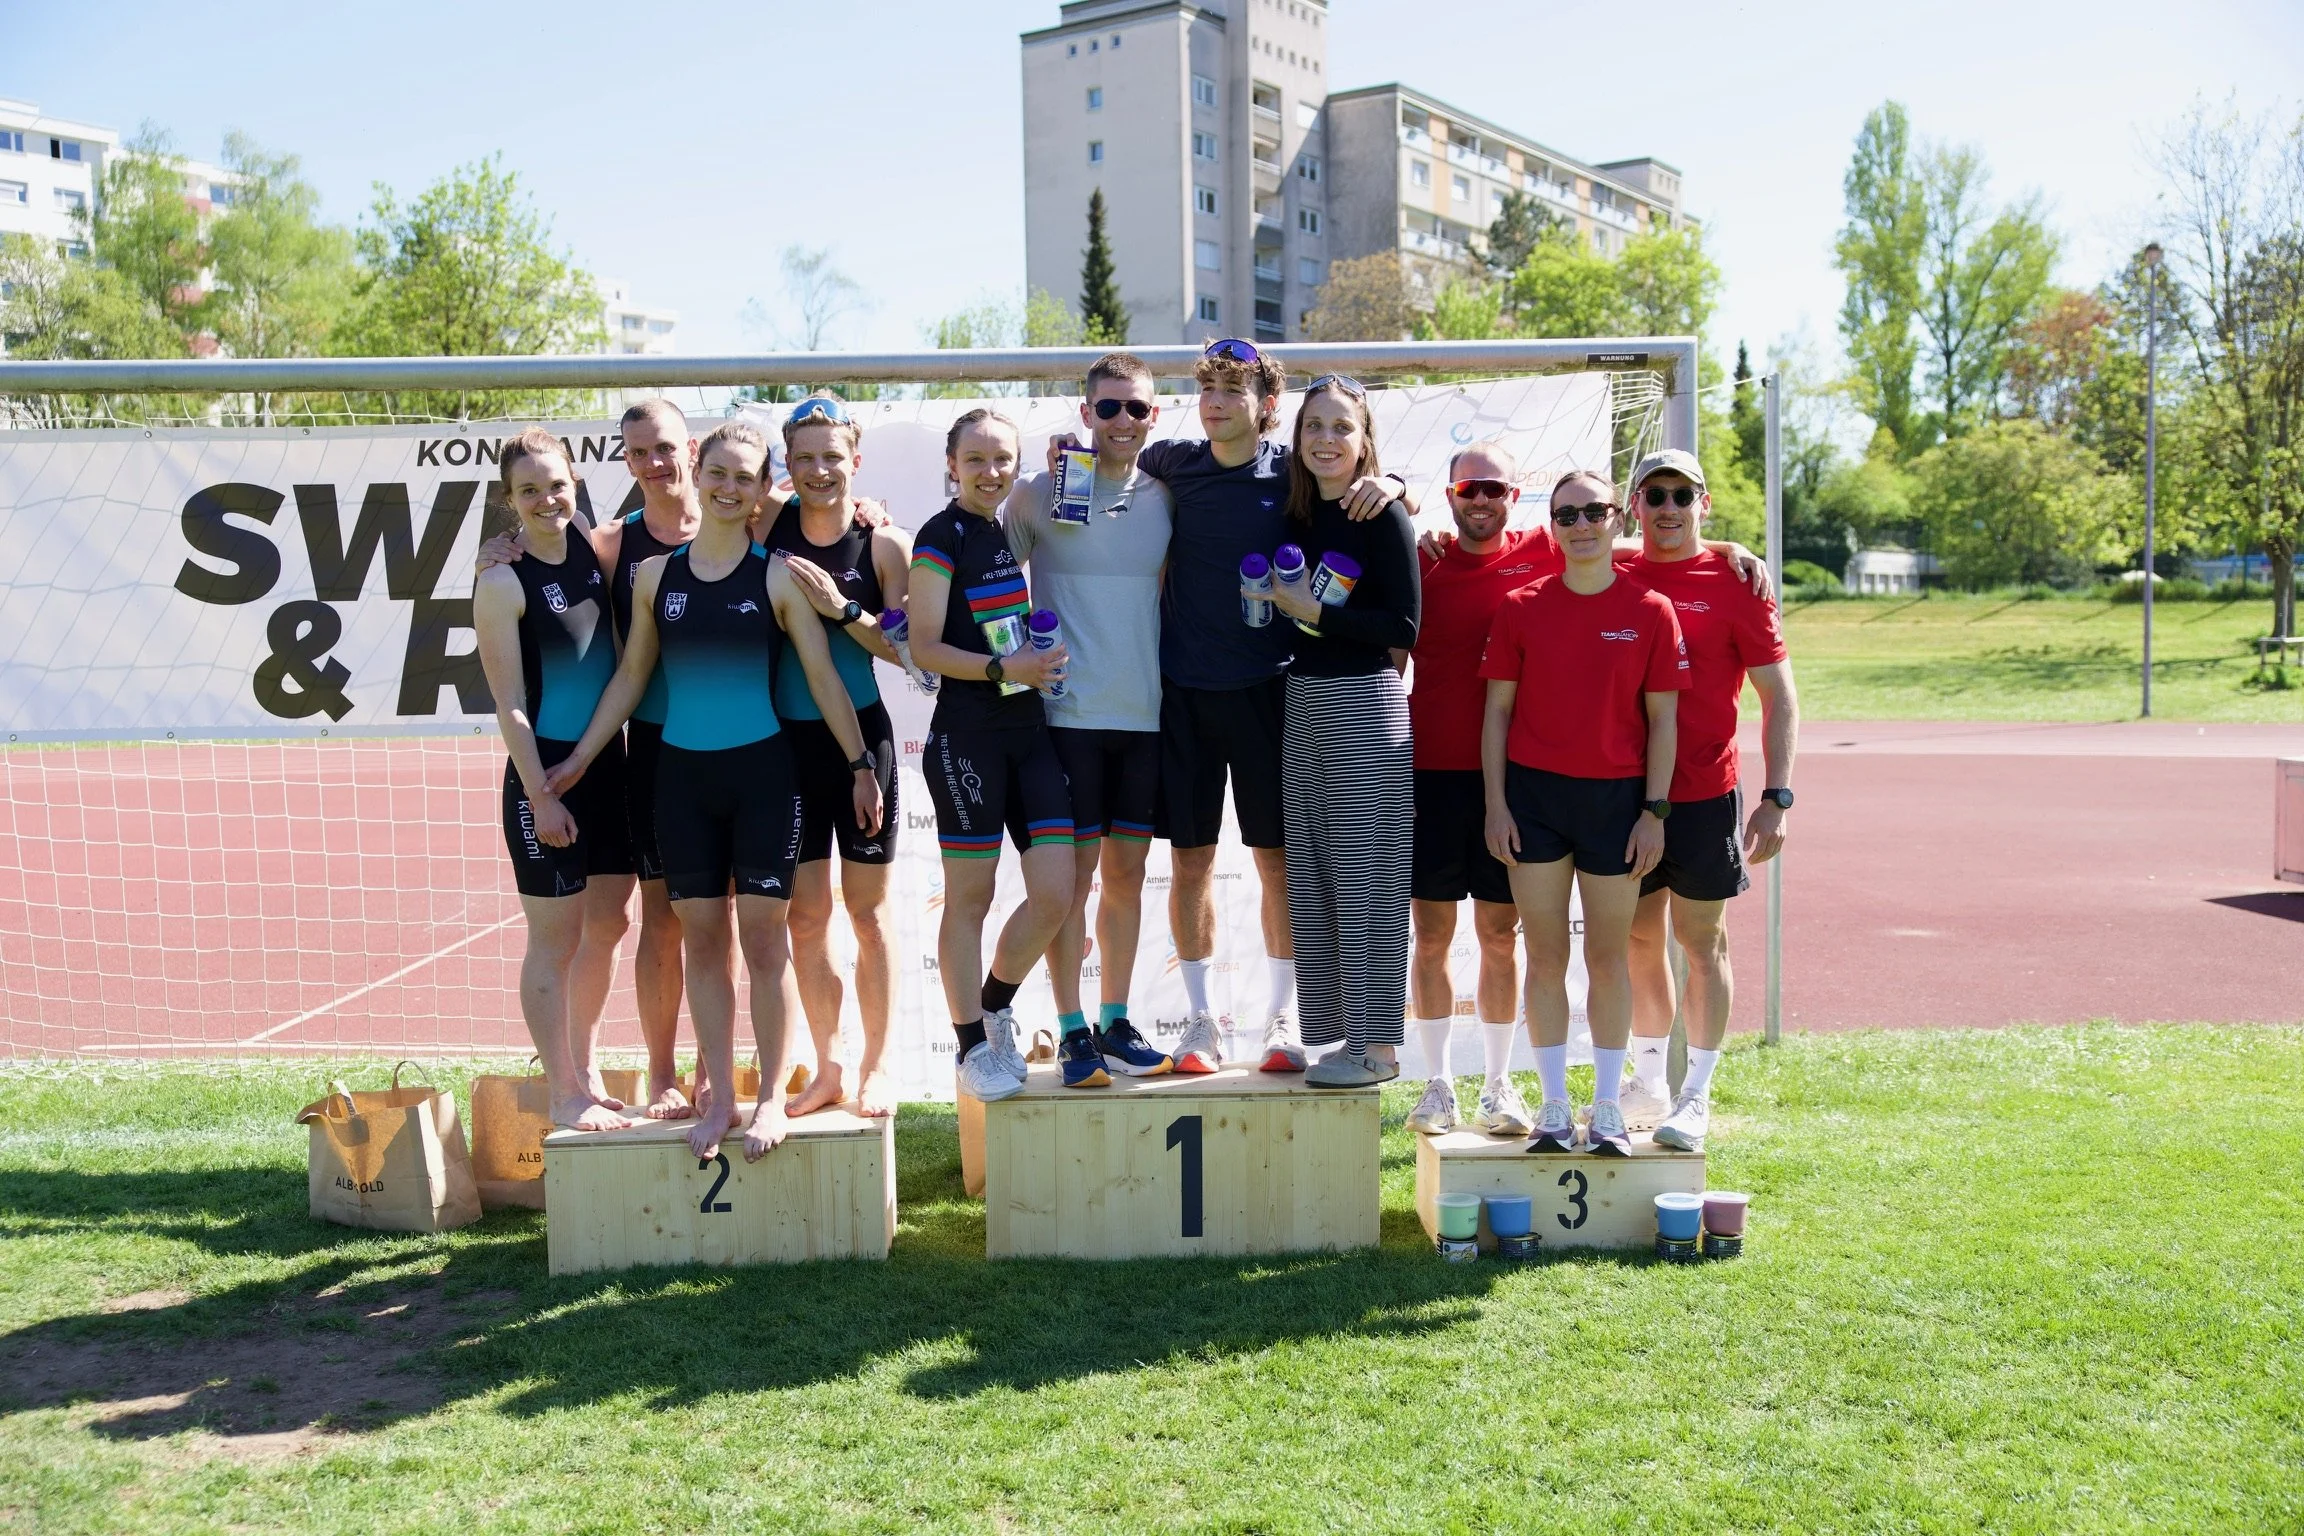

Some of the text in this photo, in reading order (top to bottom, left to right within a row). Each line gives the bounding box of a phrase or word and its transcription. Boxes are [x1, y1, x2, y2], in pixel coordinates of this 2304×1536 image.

[416, 434, 626, 467] KONANZ
[1052, 460, 1064, 514] Xenofit
[544, 583, 559, 594] SSV
[727, 602, 753, 611] kiwami
[1312, 572, 1328, 597] ofit
[253, 600, 355, 723] &
[941, 734, 971, 831] TRI-TEAM HEUCHELBERG
[518, 800, 545, 859] kiwami
[785, 796, 801, 860] kiwami
[1726, 836, 1735, 863] adidas
[1213, 871, 1242, 881] nsoring
[1156, 1016, 1190, 1037] bwt
[698, 1153, 731, 1213] 2
[1166, 1115, 1203, 1237] 1
[1556, 1169, 1588, 1230] 3
